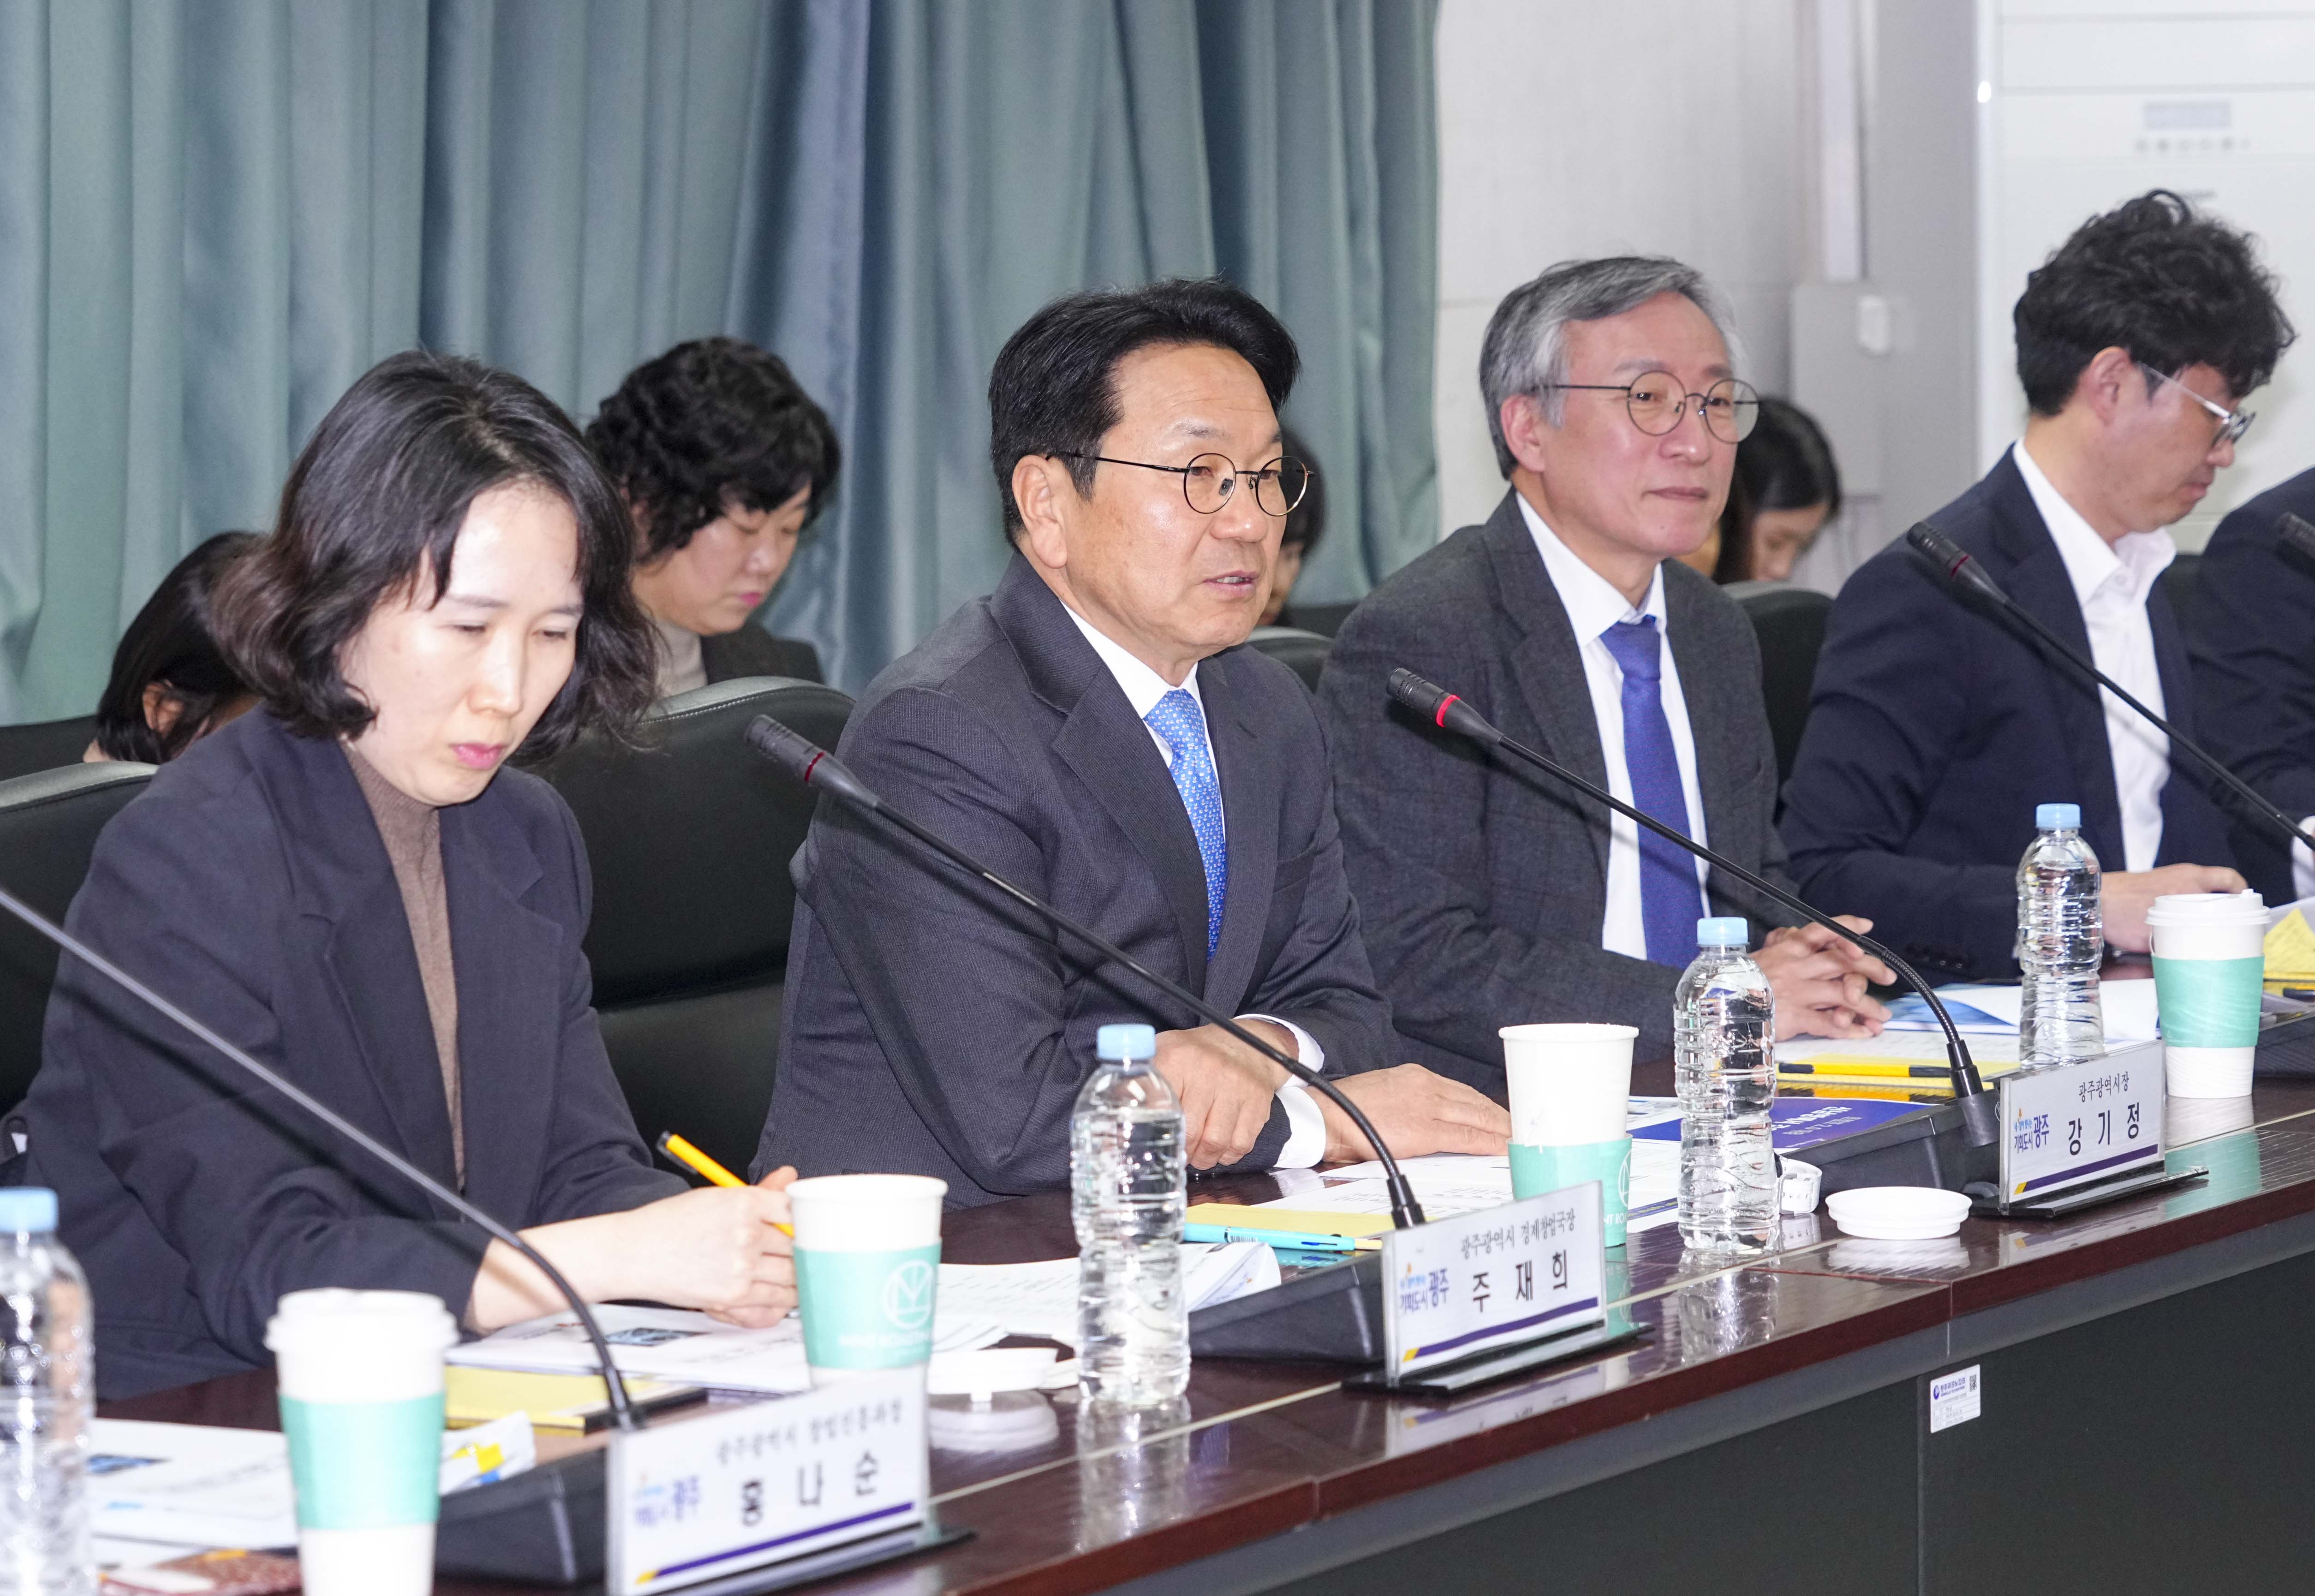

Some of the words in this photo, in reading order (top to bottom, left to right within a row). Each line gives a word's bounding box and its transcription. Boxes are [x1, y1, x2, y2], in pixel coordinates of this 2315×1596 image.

[2079, 1071, 2130, 1103] 광주광역시장
[2014, 1131, 2033, 1154] 기회도시
[2033, 1114, 2049, 1148] 광주
[2068, 1102, 2140, 1155] 강기정
[1462, 1225, 1515, 1260] 광주광역시
[1521, 1208, 1576, 1245] 경제창업국장
[1428, 1268, 1450, 1308] 광주
[1473, 1249, 1569, 1313] 주재희
